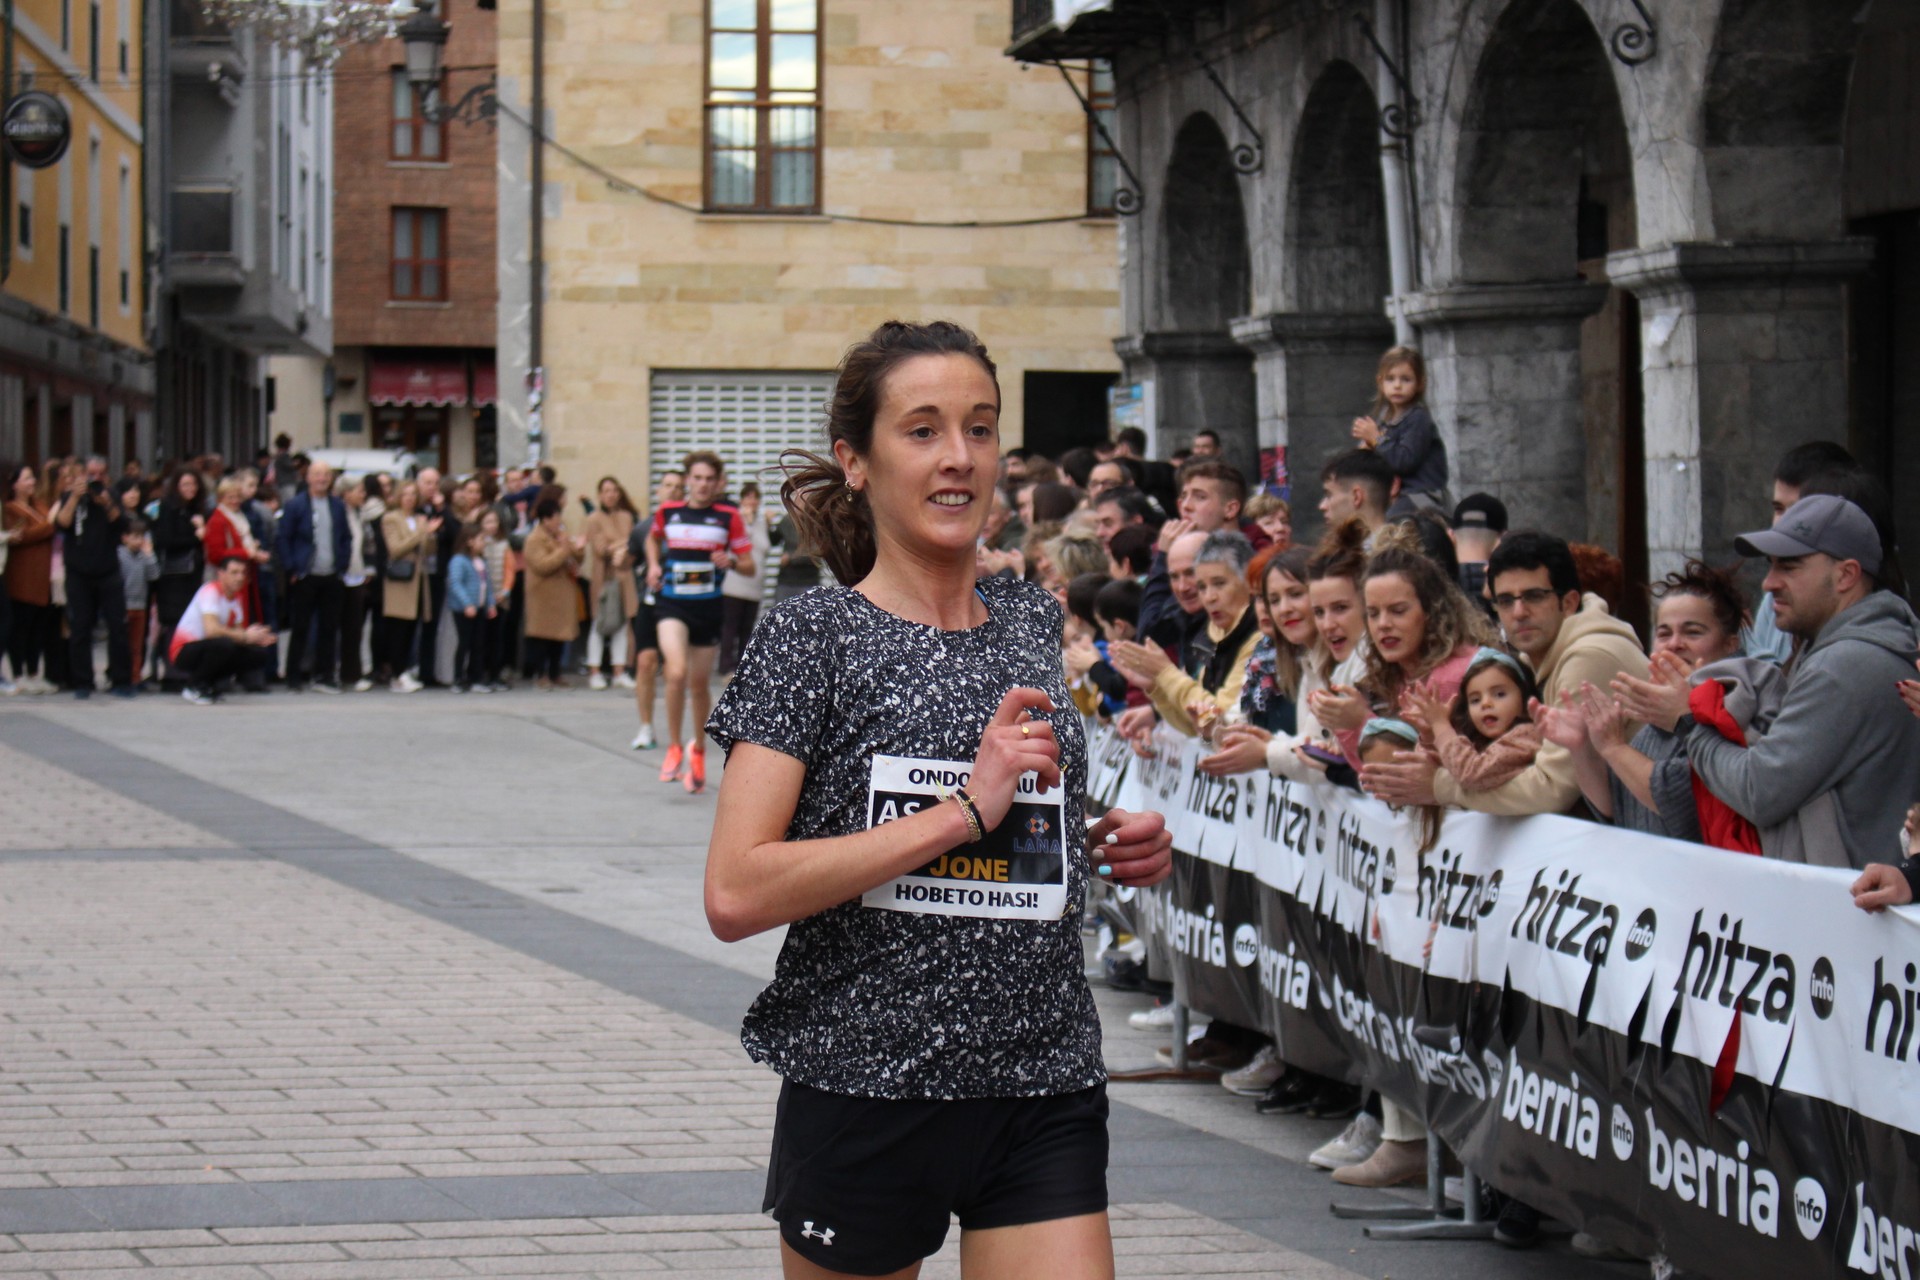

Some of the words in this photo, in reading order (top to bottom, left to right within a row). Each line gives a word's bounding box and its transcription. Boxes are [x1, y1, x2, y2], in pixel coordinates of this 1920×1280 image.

[1013, 837, 1062, 854] LANA
[1264, 771, 1311, 856] hitza
[1336, 809, 1379, 898] hitza
[895, 883, 985, 907] HOBETO
[988, 891, 1039, 908] HASI!
[929, 855, 1009, 882] JONE
[1416, 848, 1484, 932] hitza
[1166, 889, 1227, 968] berria
[1235, 934, 1257, 954] info
[1511, 865, 1620, 968] hitza
[1627, 921, 1655, 948] info
[1257, 924, 1311, 1010] erria
[1682, 907, 1796, 1025] hitza
[1811, 972, 1834, 1002] info
[1865, 956, 1920, 1064] hi
[1502, 1045, 1600, 1160] berria
[1613, 1117, 1633, 1145] info
[1644, 1107, 1780, 1239] berria
[1796, 1193, 1823, 1223] info
[1847, 1181, 1920, 1280] ber
